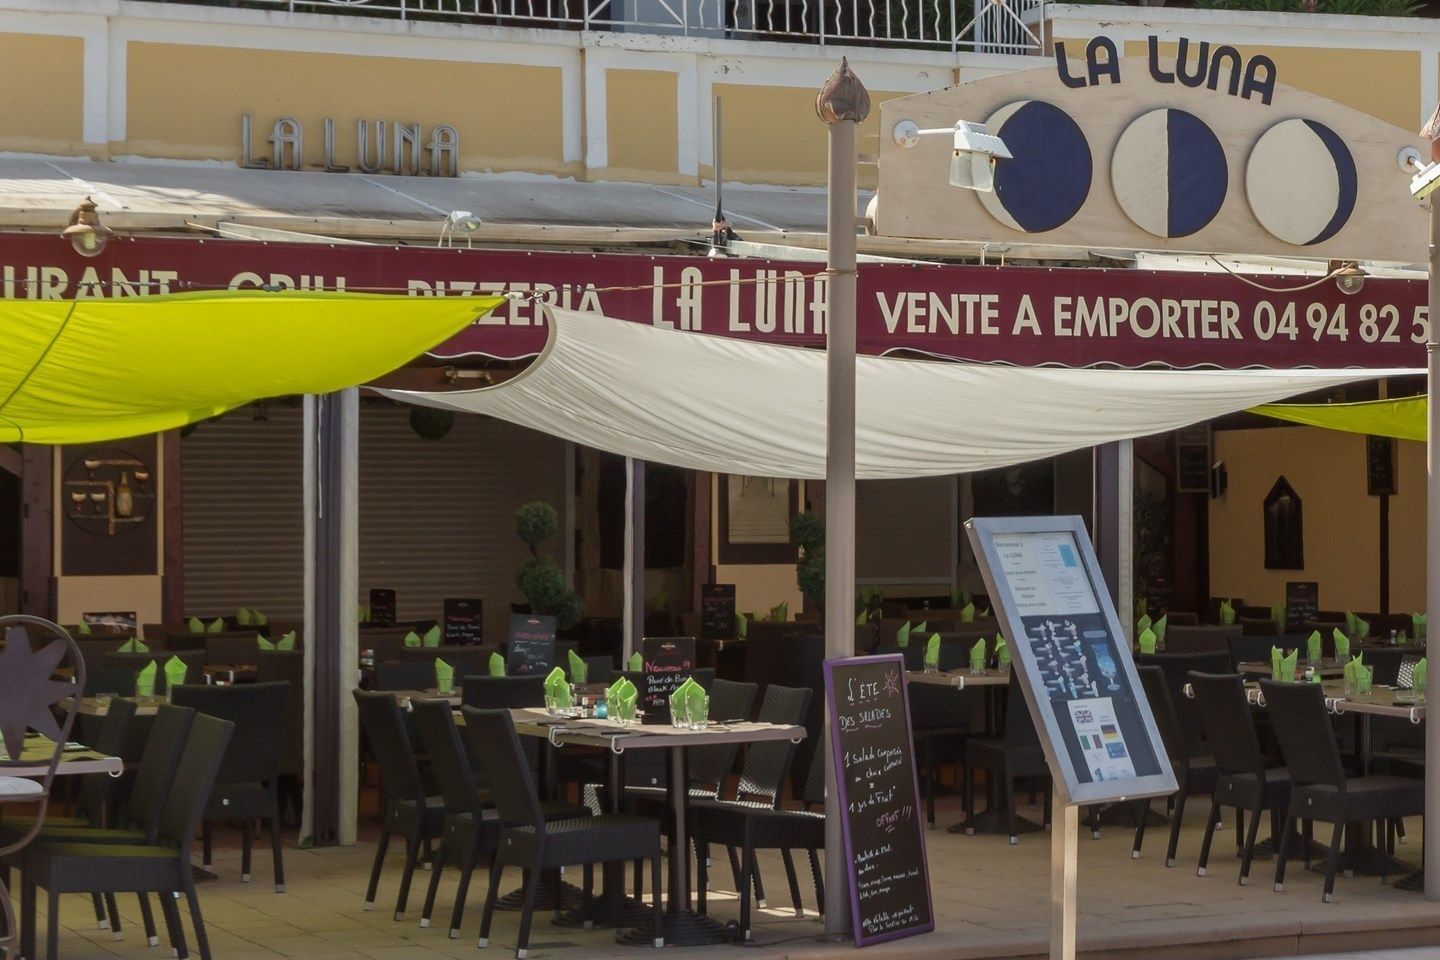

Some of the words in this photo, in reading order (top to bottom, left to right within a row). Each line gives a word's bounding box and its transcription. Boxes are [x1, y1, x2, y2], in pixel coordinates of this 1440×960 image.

[1054, 35, 1121, 88] LA
[1147, 35, 1277, 106] LUNA
[241, 113, 303, 171] LA
[324, 118, 459, 178] LUNA
[653, 266, 702, 332] LA
[875, 291, 1000, 335] VENTE
[1011, 294, 1042, 336] A
[1053, 295, 1243, 340] EMPORTER
[1253, 300, 1299, 341] 04
[1306, 303, 1349, 342] 94
[1359, 303, 1401, 343] 82
[1411, 305, 1429, 343] 5
[838, 715, 856, 731] DES
[859, 708, 891, 723] SALADES
